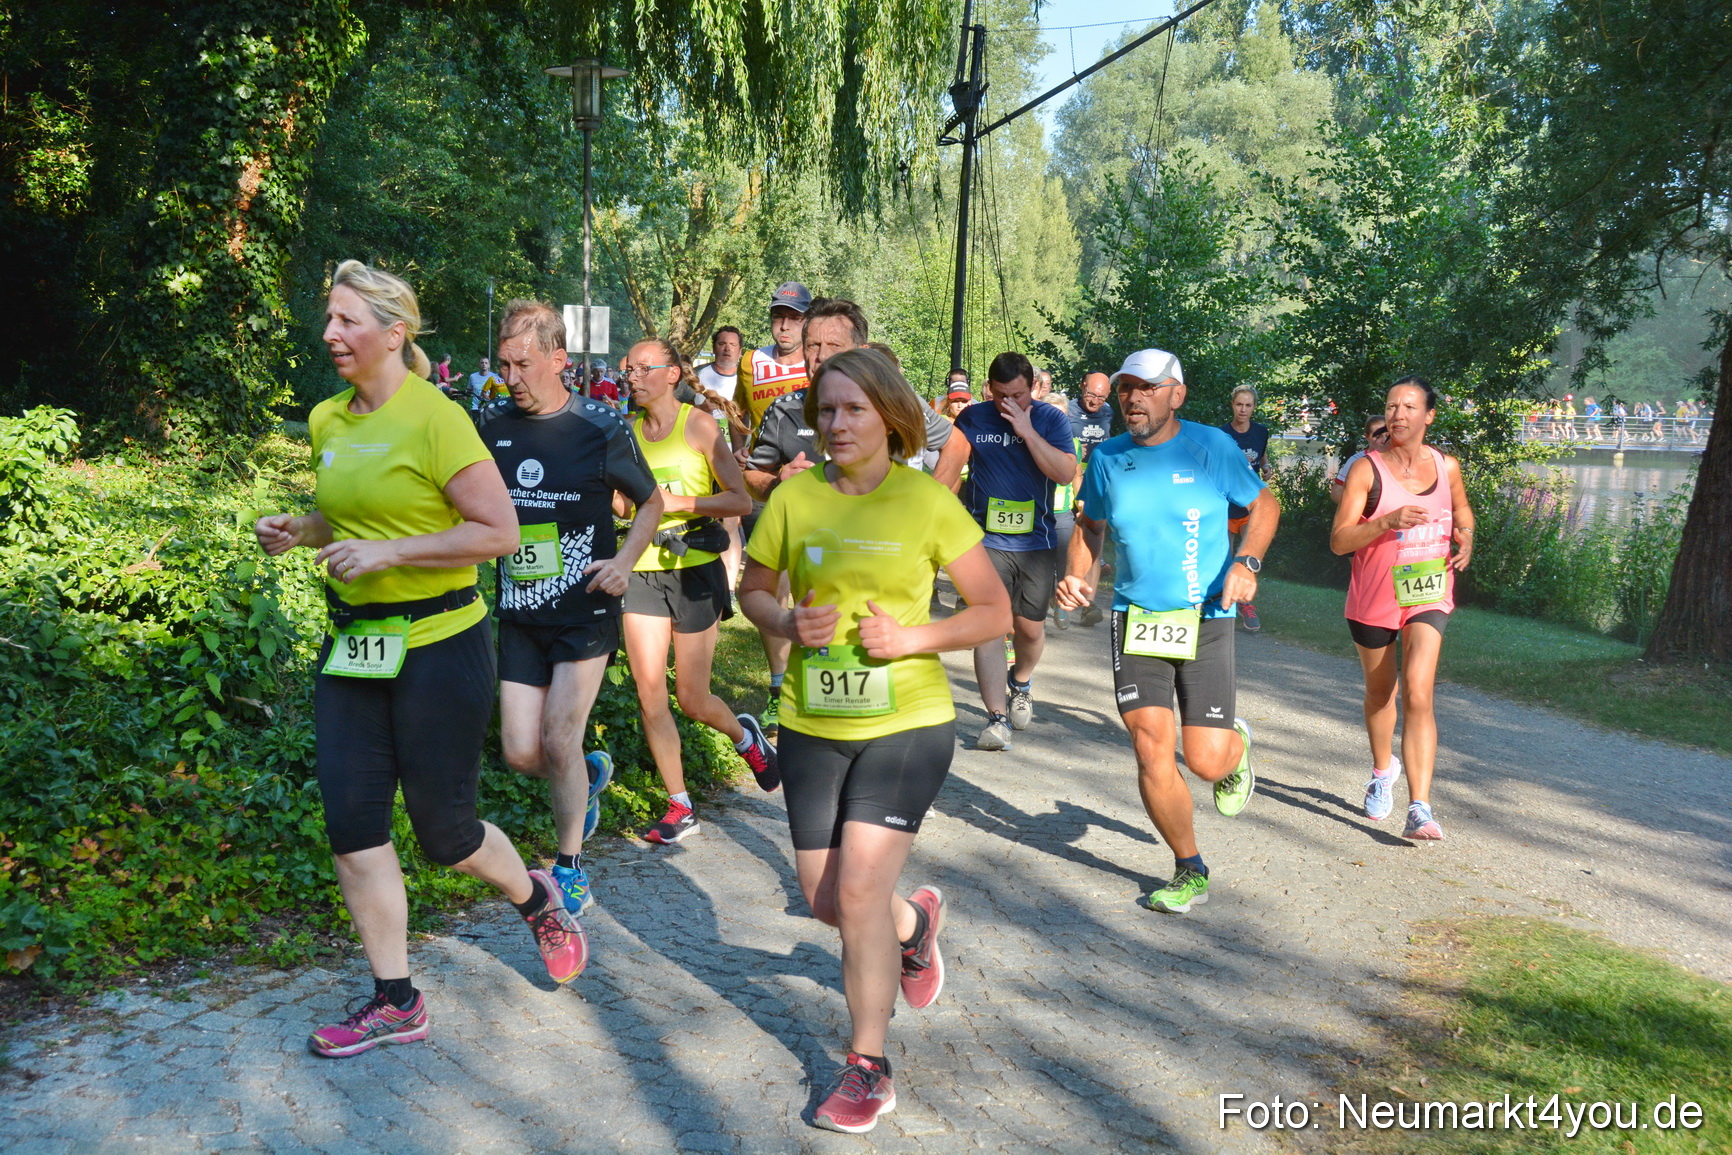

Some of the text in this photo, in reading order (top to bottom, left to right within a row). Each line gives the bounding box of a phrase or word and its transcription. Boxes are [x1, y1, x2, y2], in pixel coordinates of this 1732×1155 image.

[753, 386, 785, 401] MAX
[976, 434, 1002, 443] EURO
[997, 512, 1024, 525] 513
[1182, 508, 1201, 603] meiko.de
[1402, 573, 1443, 594] 1447
[1134, 623, 1188, 645] 2132
[347, 635, 385, 661] 911
[820, 670, 871, 696] 917
[885, 816, 907, 826] adidas
